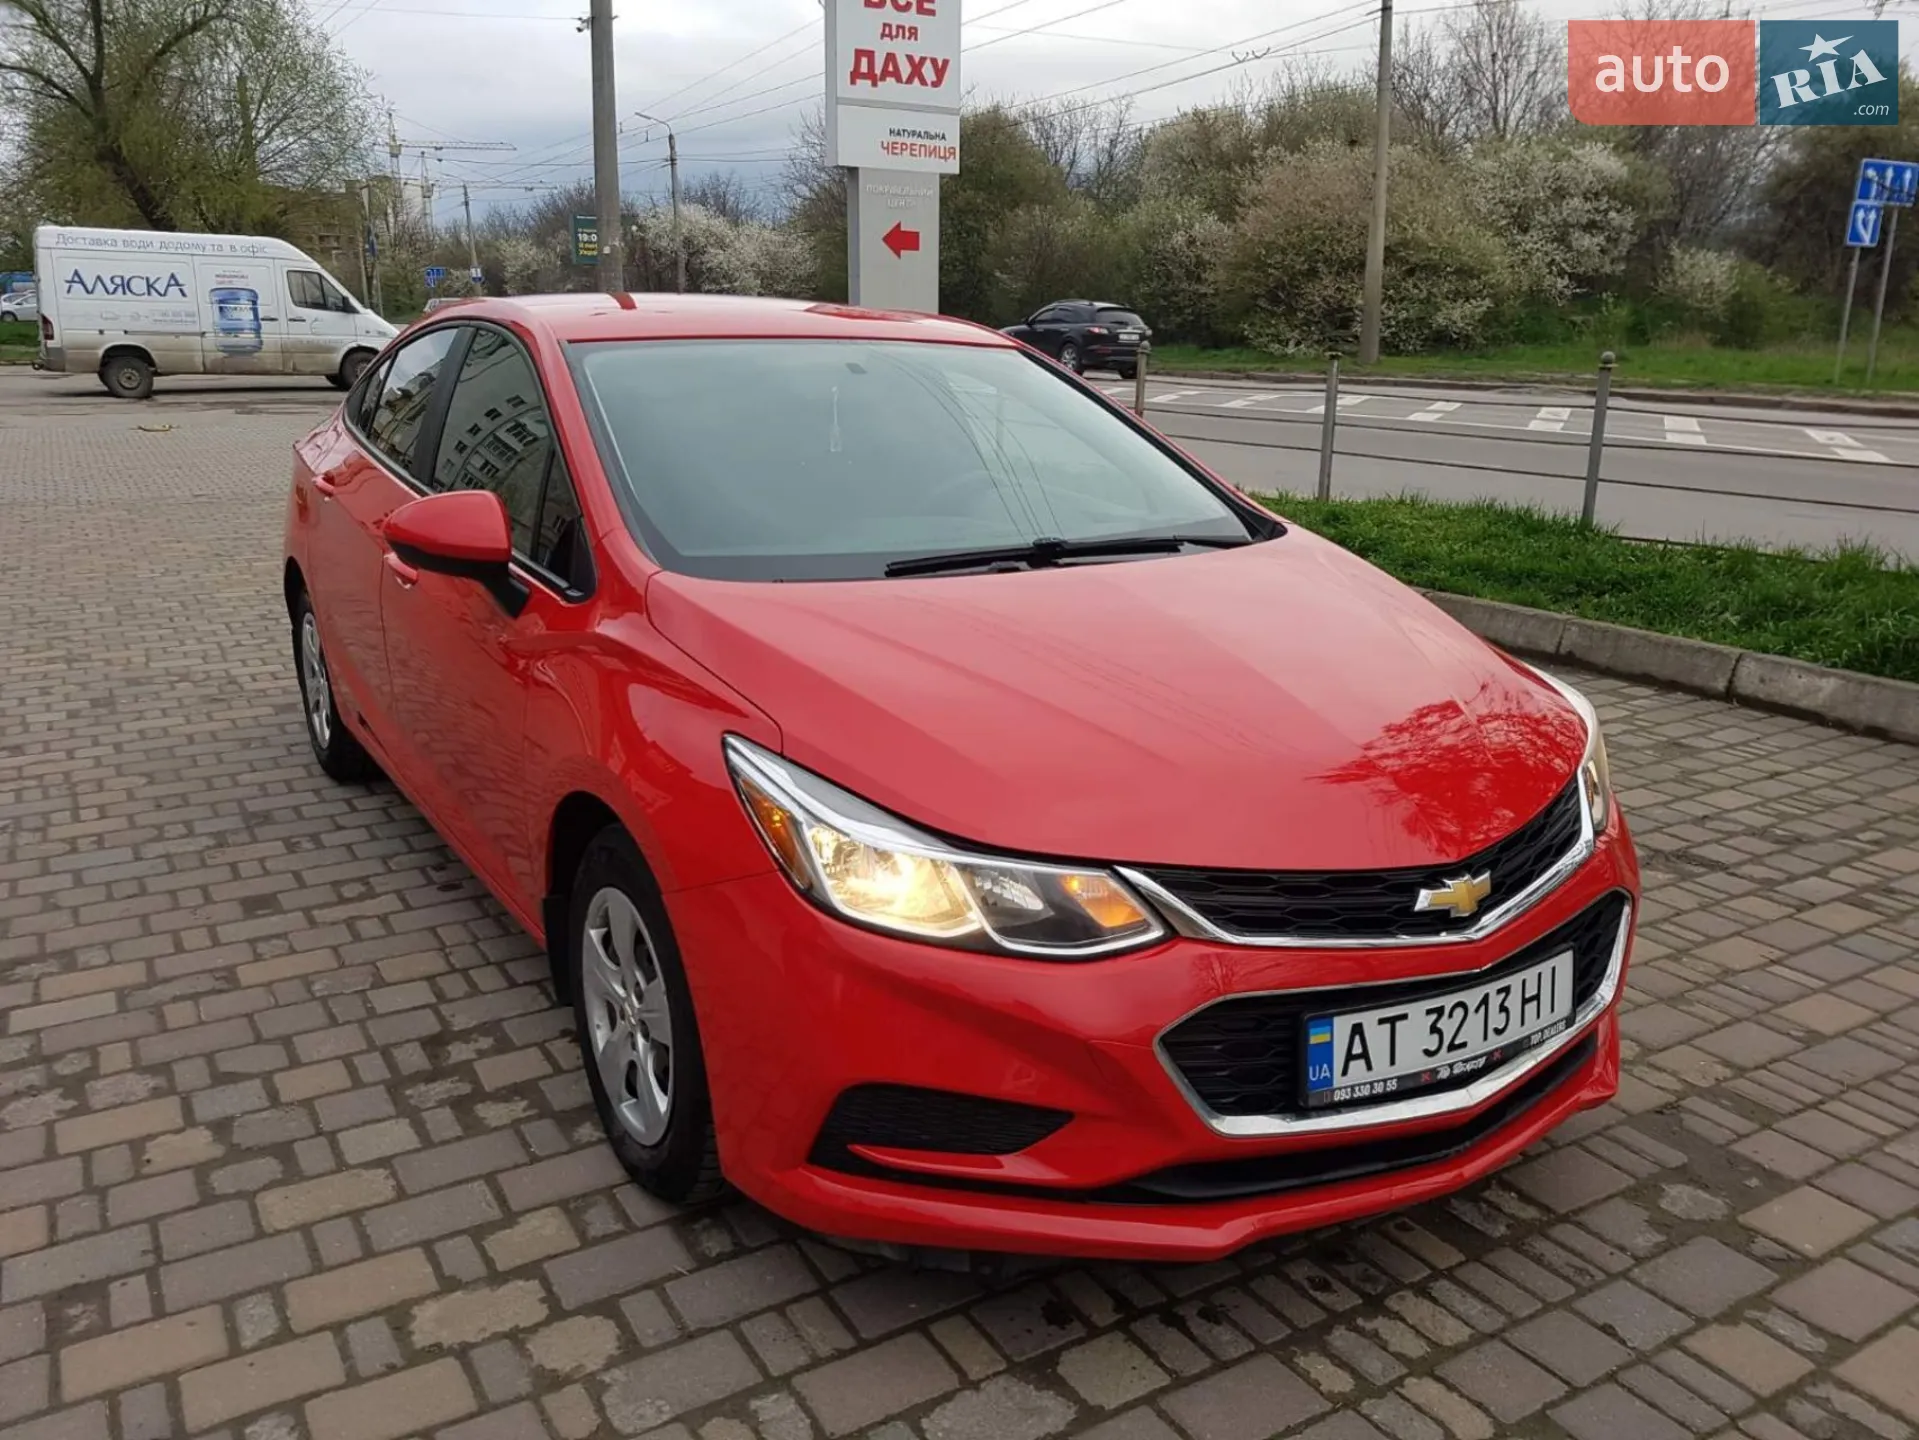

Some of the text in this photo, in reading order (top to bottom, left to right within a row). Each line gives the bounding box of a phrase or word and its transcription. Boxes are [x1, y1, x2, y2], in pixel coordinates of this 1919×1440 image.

[849, 47, 951, 89] ДАХУ
[888, 127, 947, 142] НАТУРАЛЬНА
[880, 140, 957, 162] ЧЕРЕПИЦЯ
[56, 232, 118, 247] Доставка
[122, 238, 154, 250] води
[159, 240, 207, 254] додому
[211, 243, 224, 252] та
[64, 268, 188, 298] АЛЯСКА
[1340, 1012, 1409, 1078] AT
[1422, 983, 1512, 1058] 3213
[1309, 1064, 1331, 1082] UA
[1333, 1078, 1398, 1102] 093 330 30 55
